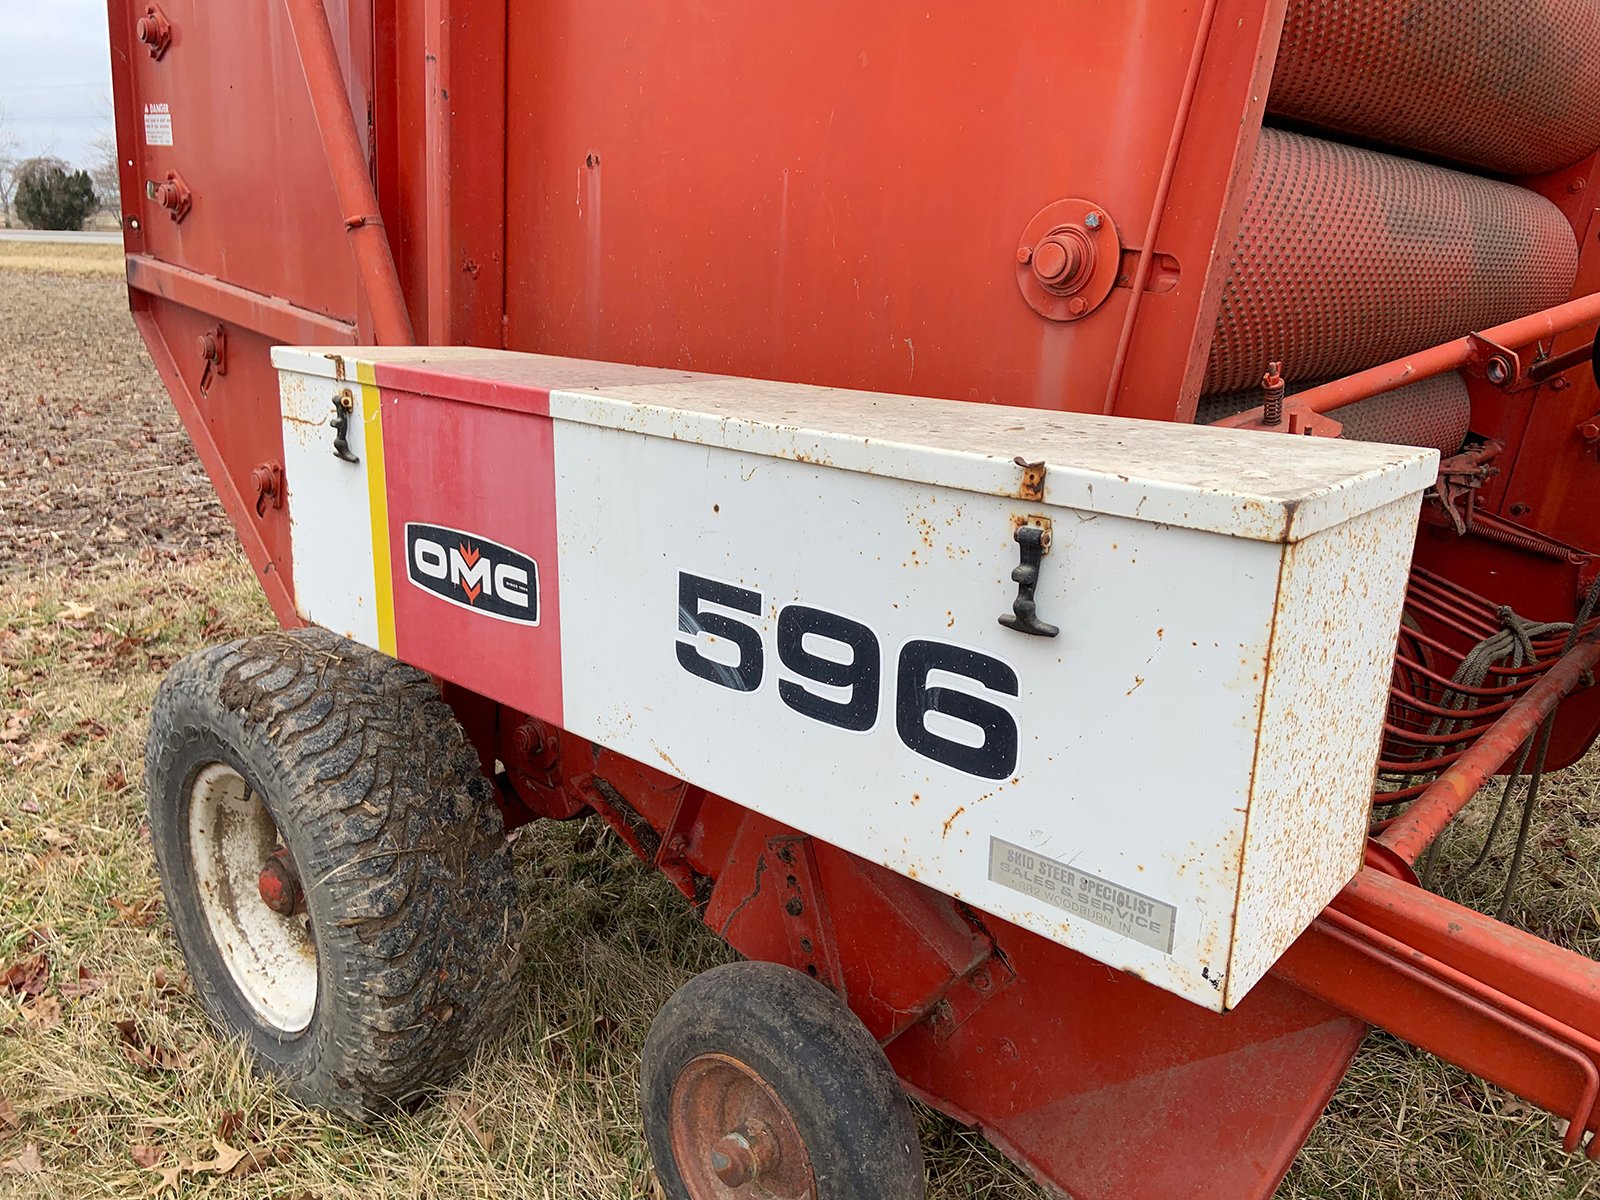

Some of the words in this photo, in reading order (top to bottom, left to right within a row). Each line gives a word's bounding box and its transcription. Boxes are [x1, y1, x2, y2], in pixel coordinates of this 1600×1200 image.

[414, 538, 529, 608] OMC
[675, 570, 1019, 781] 596
[1000, 862, 1055, 892] SALES
[1061, 886, 1073, 899] &
[1078, 893, 1160, 934] SERVICE
[1007, 849, 1034, 871] SKID
[1039, 861, 1075, 888] STEER
[1080, 877, 1155, 917] SPECIALIST
